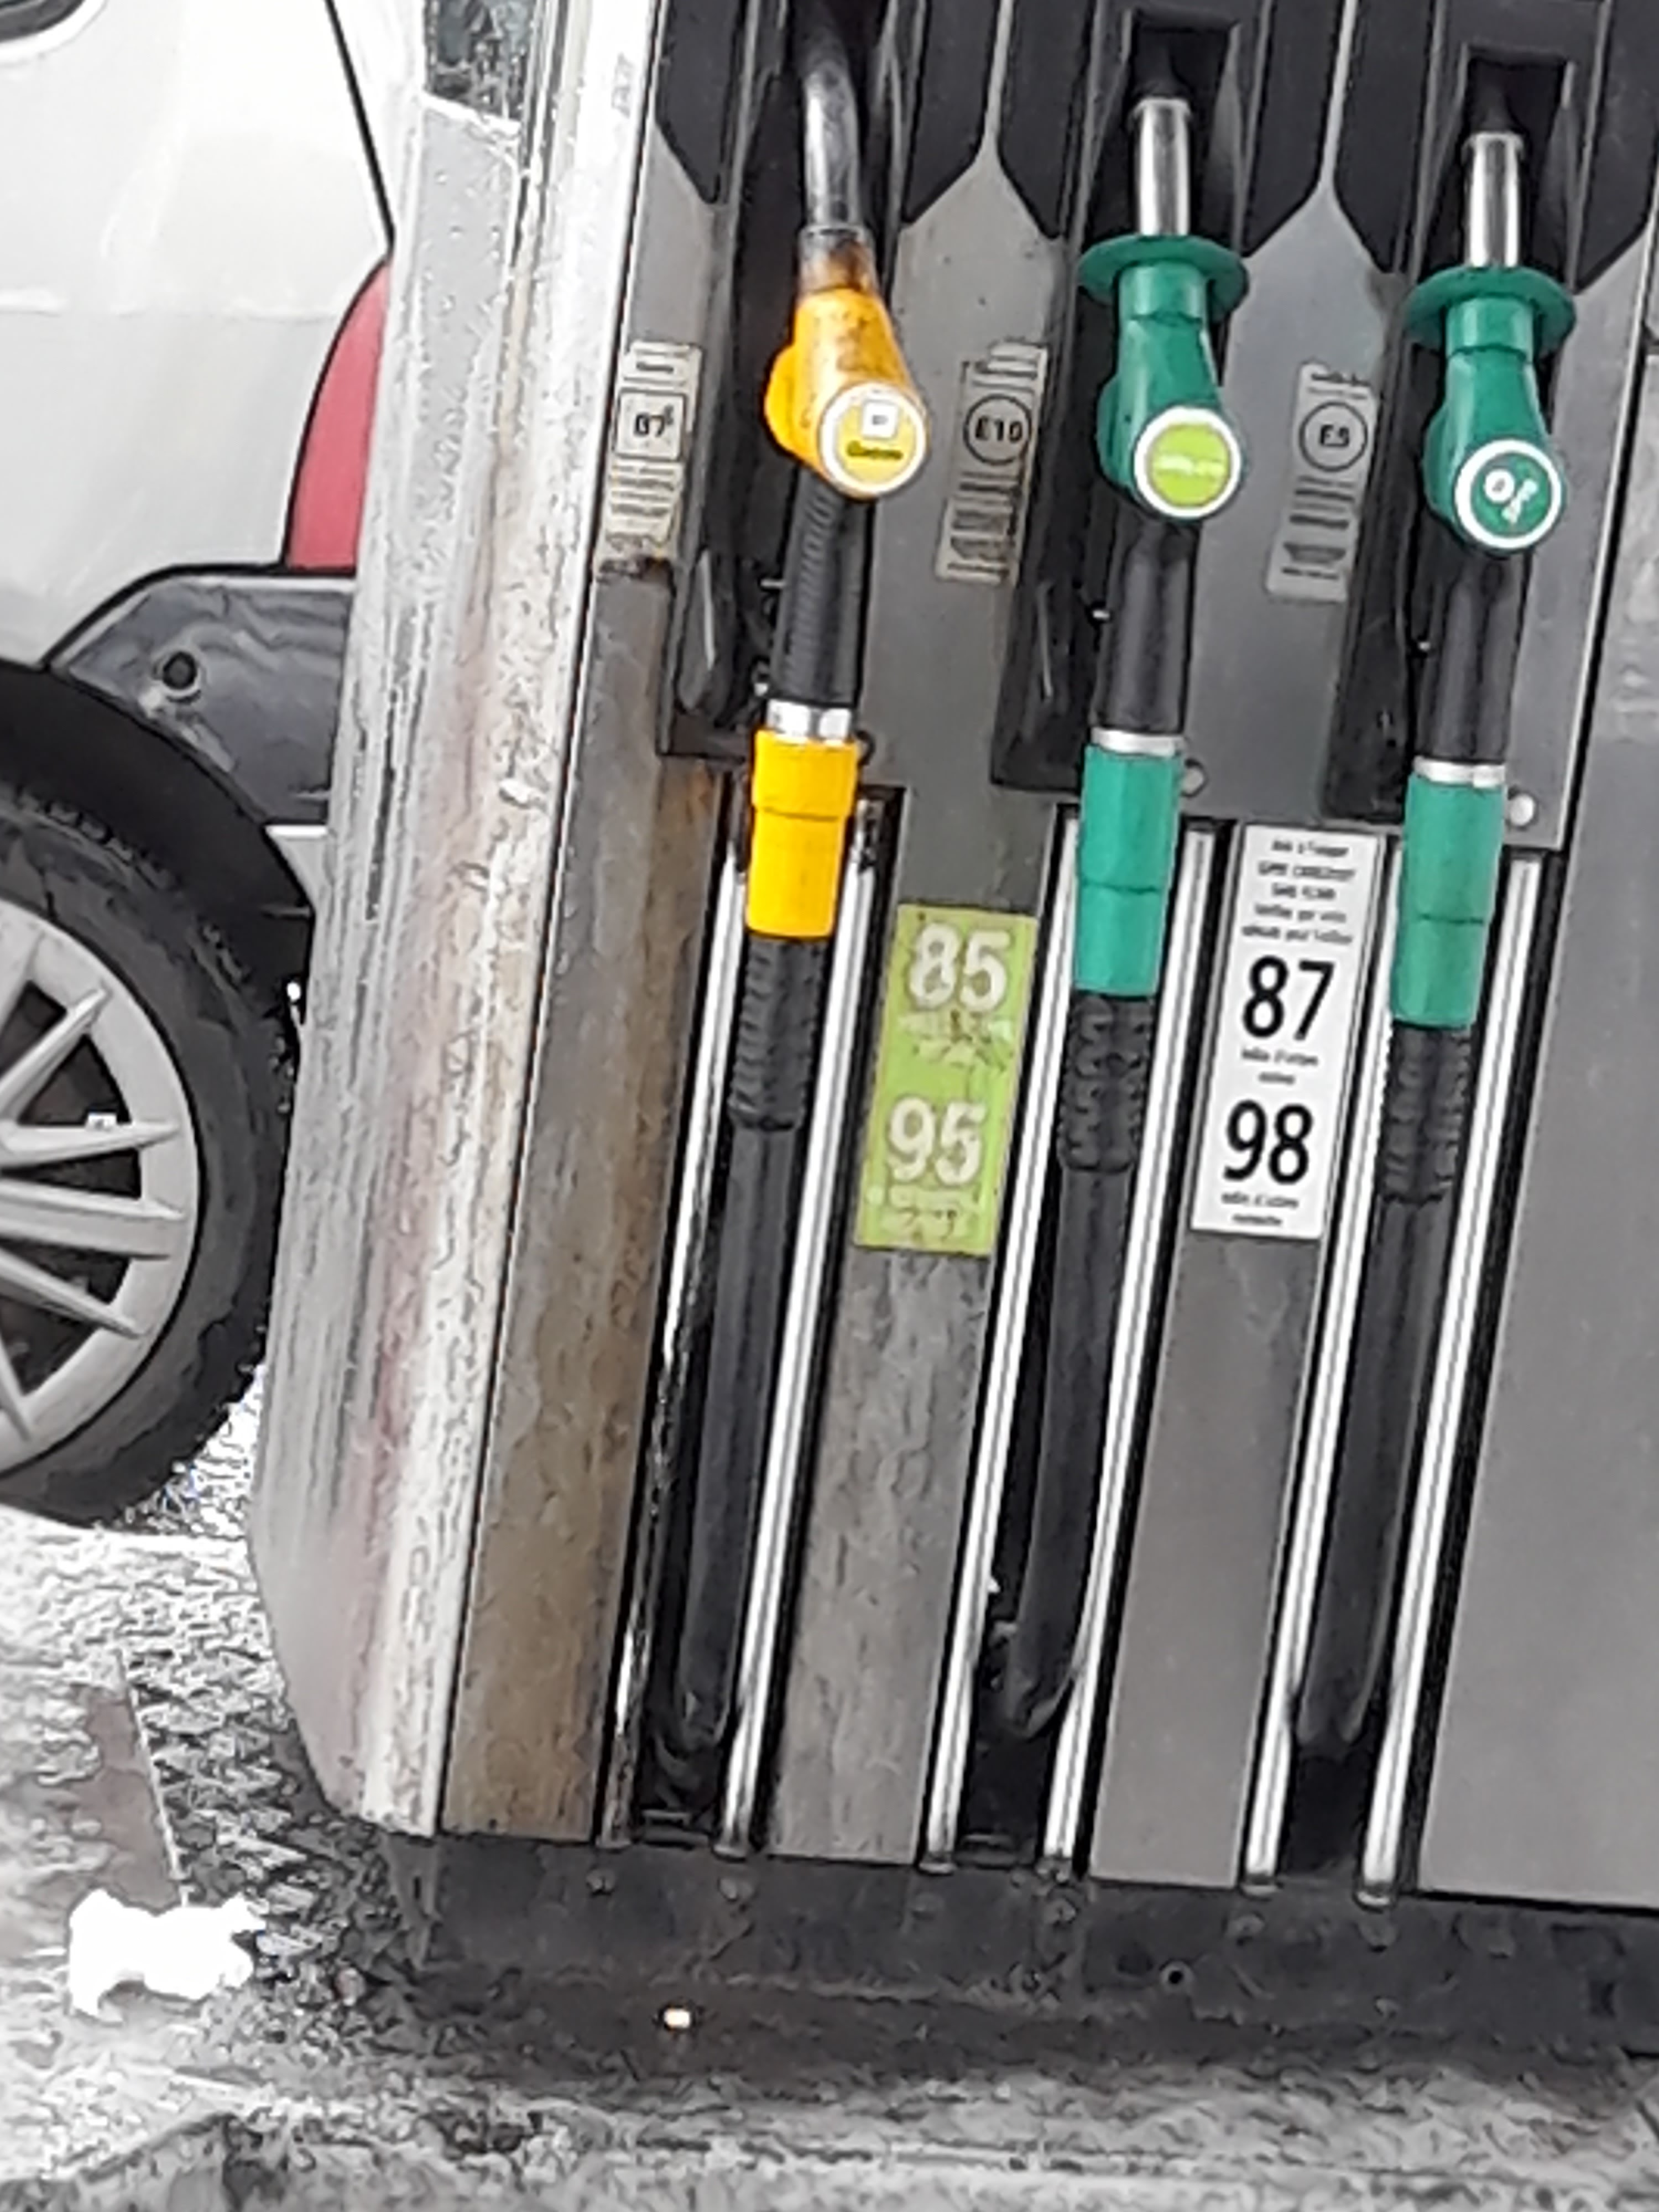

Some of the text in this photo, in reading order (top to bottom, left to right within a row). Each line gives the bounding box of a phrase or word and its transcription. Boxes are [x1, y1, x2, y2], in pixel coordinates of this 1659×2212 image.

[975, 415, 1022, 443] E10
[907, 922, 1011, 1013] 85
[1241, 954, 1335, 1041] 87
[888, 1097, 986, 1185] 95
[1223, 1099, 1313, 1185] 98
